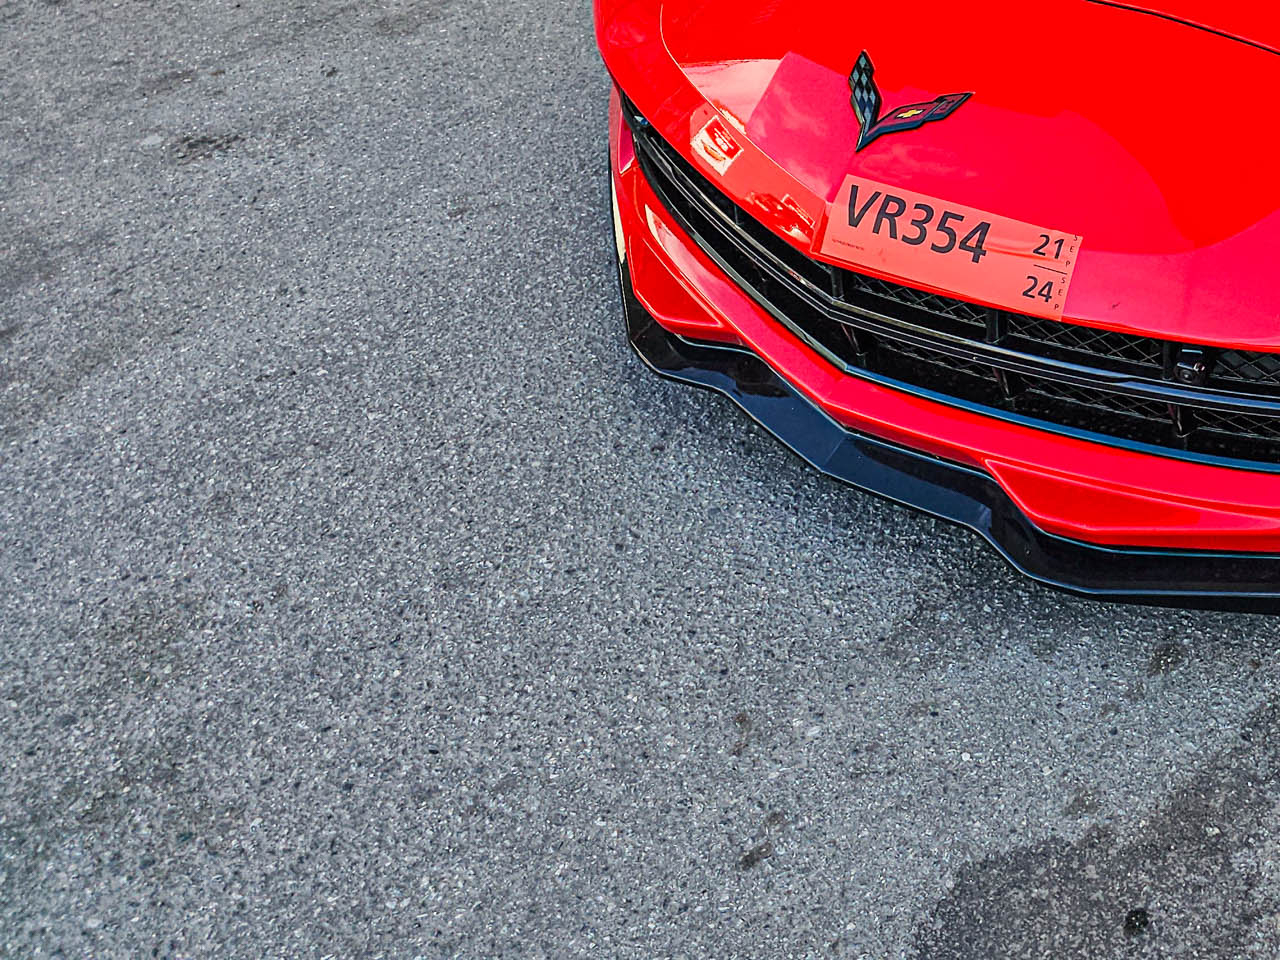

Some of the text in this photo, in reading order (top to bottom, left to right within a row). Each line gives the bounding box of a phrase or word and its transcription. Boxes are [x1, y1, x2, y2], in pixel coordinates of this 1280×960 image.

[847, 184, 992, 264] VR354
[1033, 233, 1065, 260] 21
[1022, 275, 1053, 303] 24
